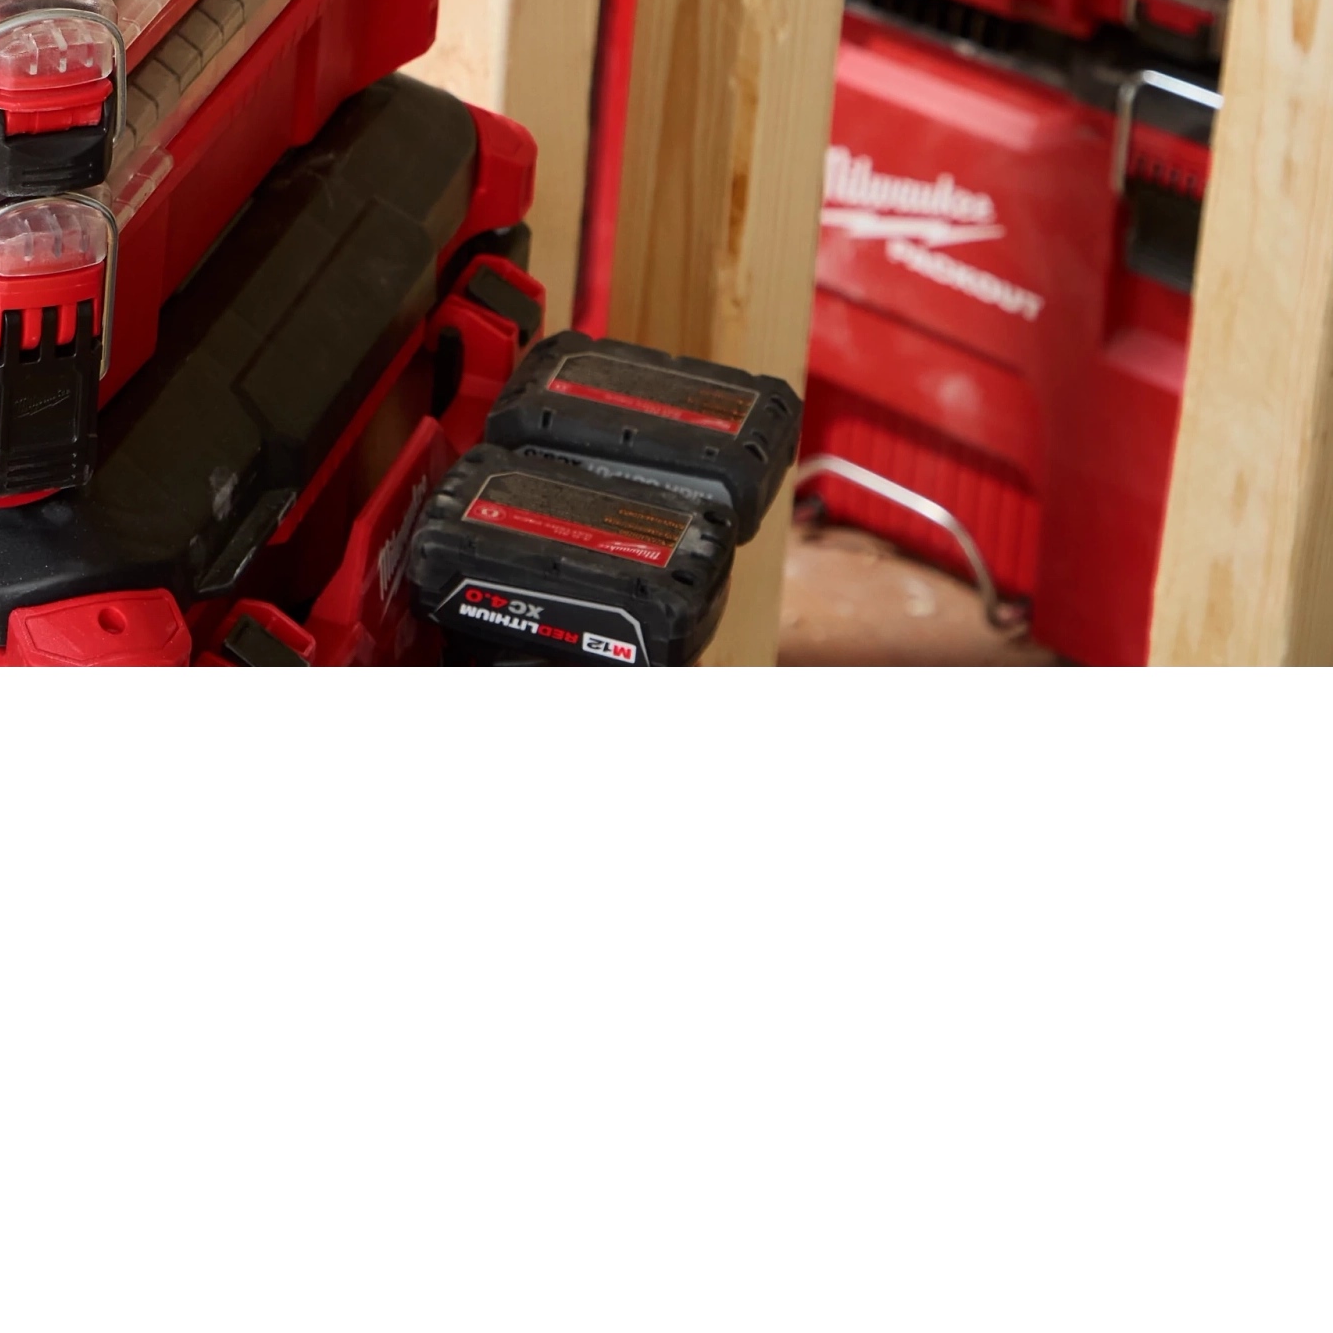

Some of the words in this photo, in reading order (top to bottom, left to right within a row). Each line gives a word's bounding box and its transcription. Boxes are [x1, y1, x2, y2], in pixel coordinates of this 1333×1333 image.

[464, 587, 545, 620] XC4.0
[458, 602, 580, 645] REDLITHIUM
[586, 636, 633, 661] M12
